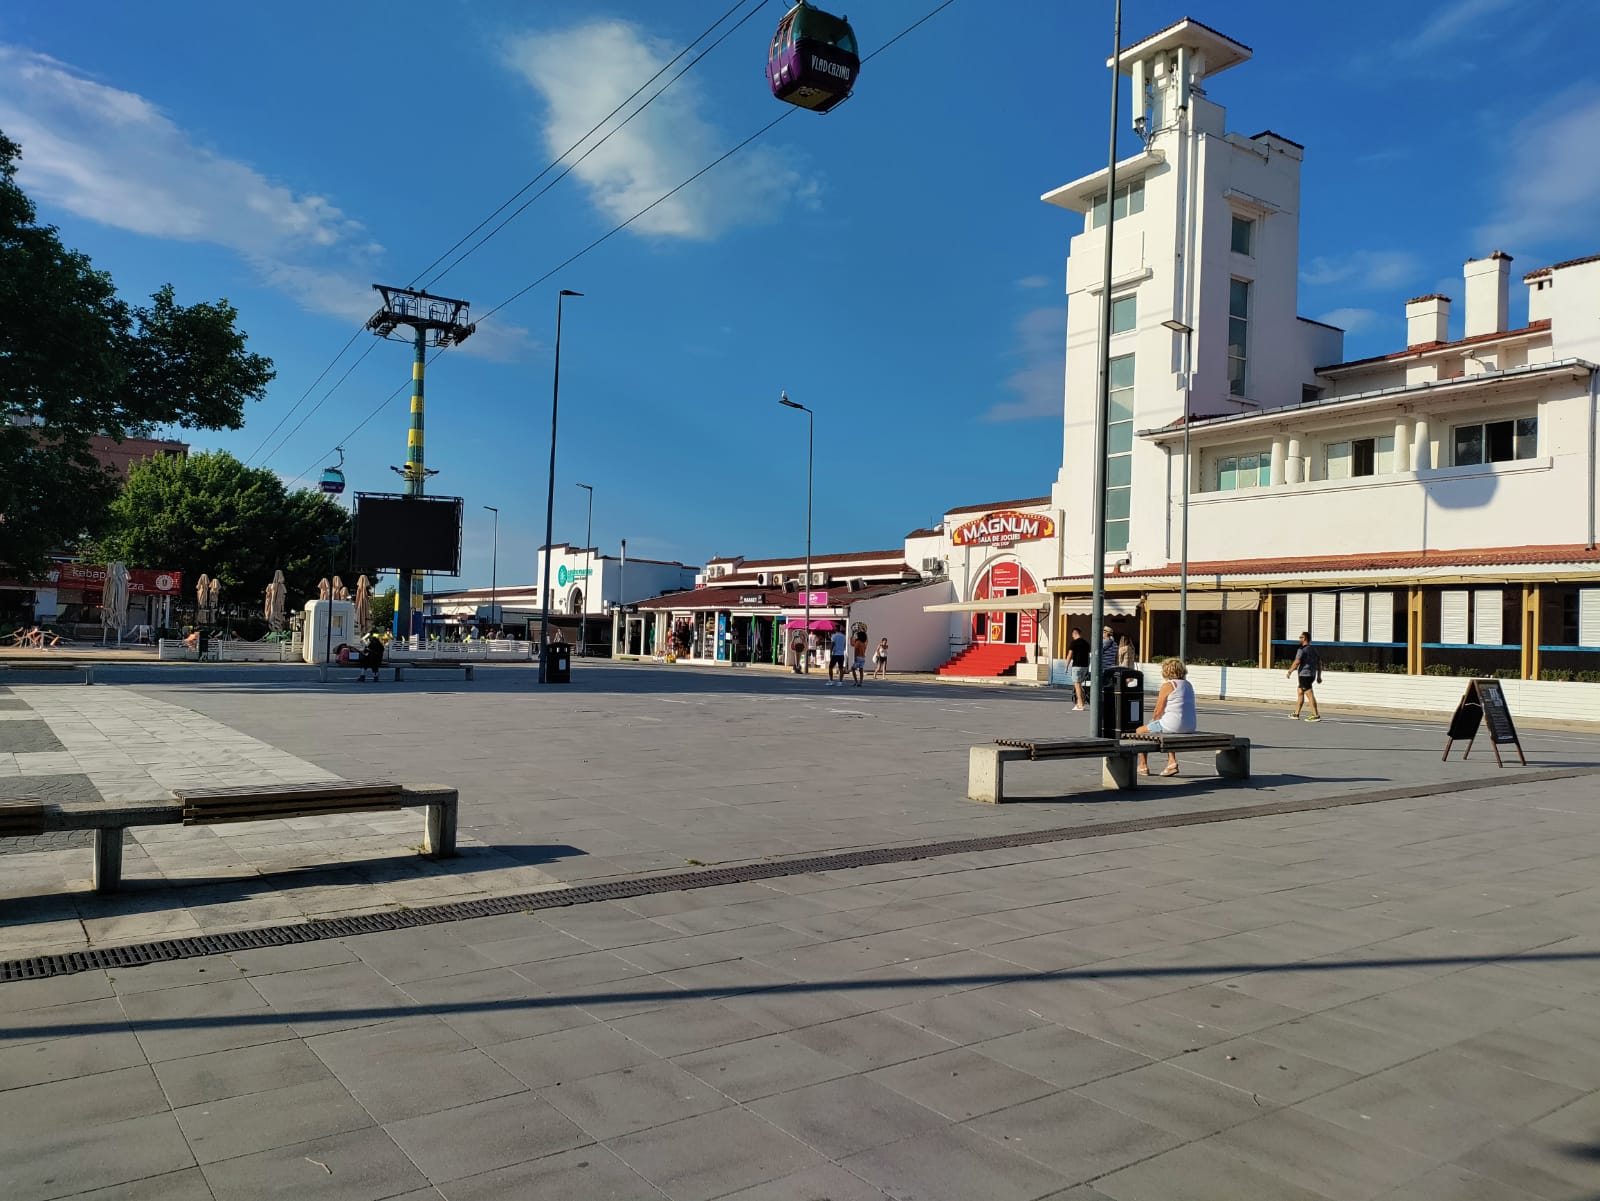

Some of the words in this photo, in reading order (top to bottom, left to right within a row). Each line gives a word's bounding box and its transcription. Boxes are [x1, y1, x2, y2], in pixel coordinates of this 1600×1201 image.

[811, 54, 829, 73] VLAD
[827, 62, 851, 80] CAZINO
[963, 517, 1040, 542] MAGNUM
[127, 580, 145, 591] zza
